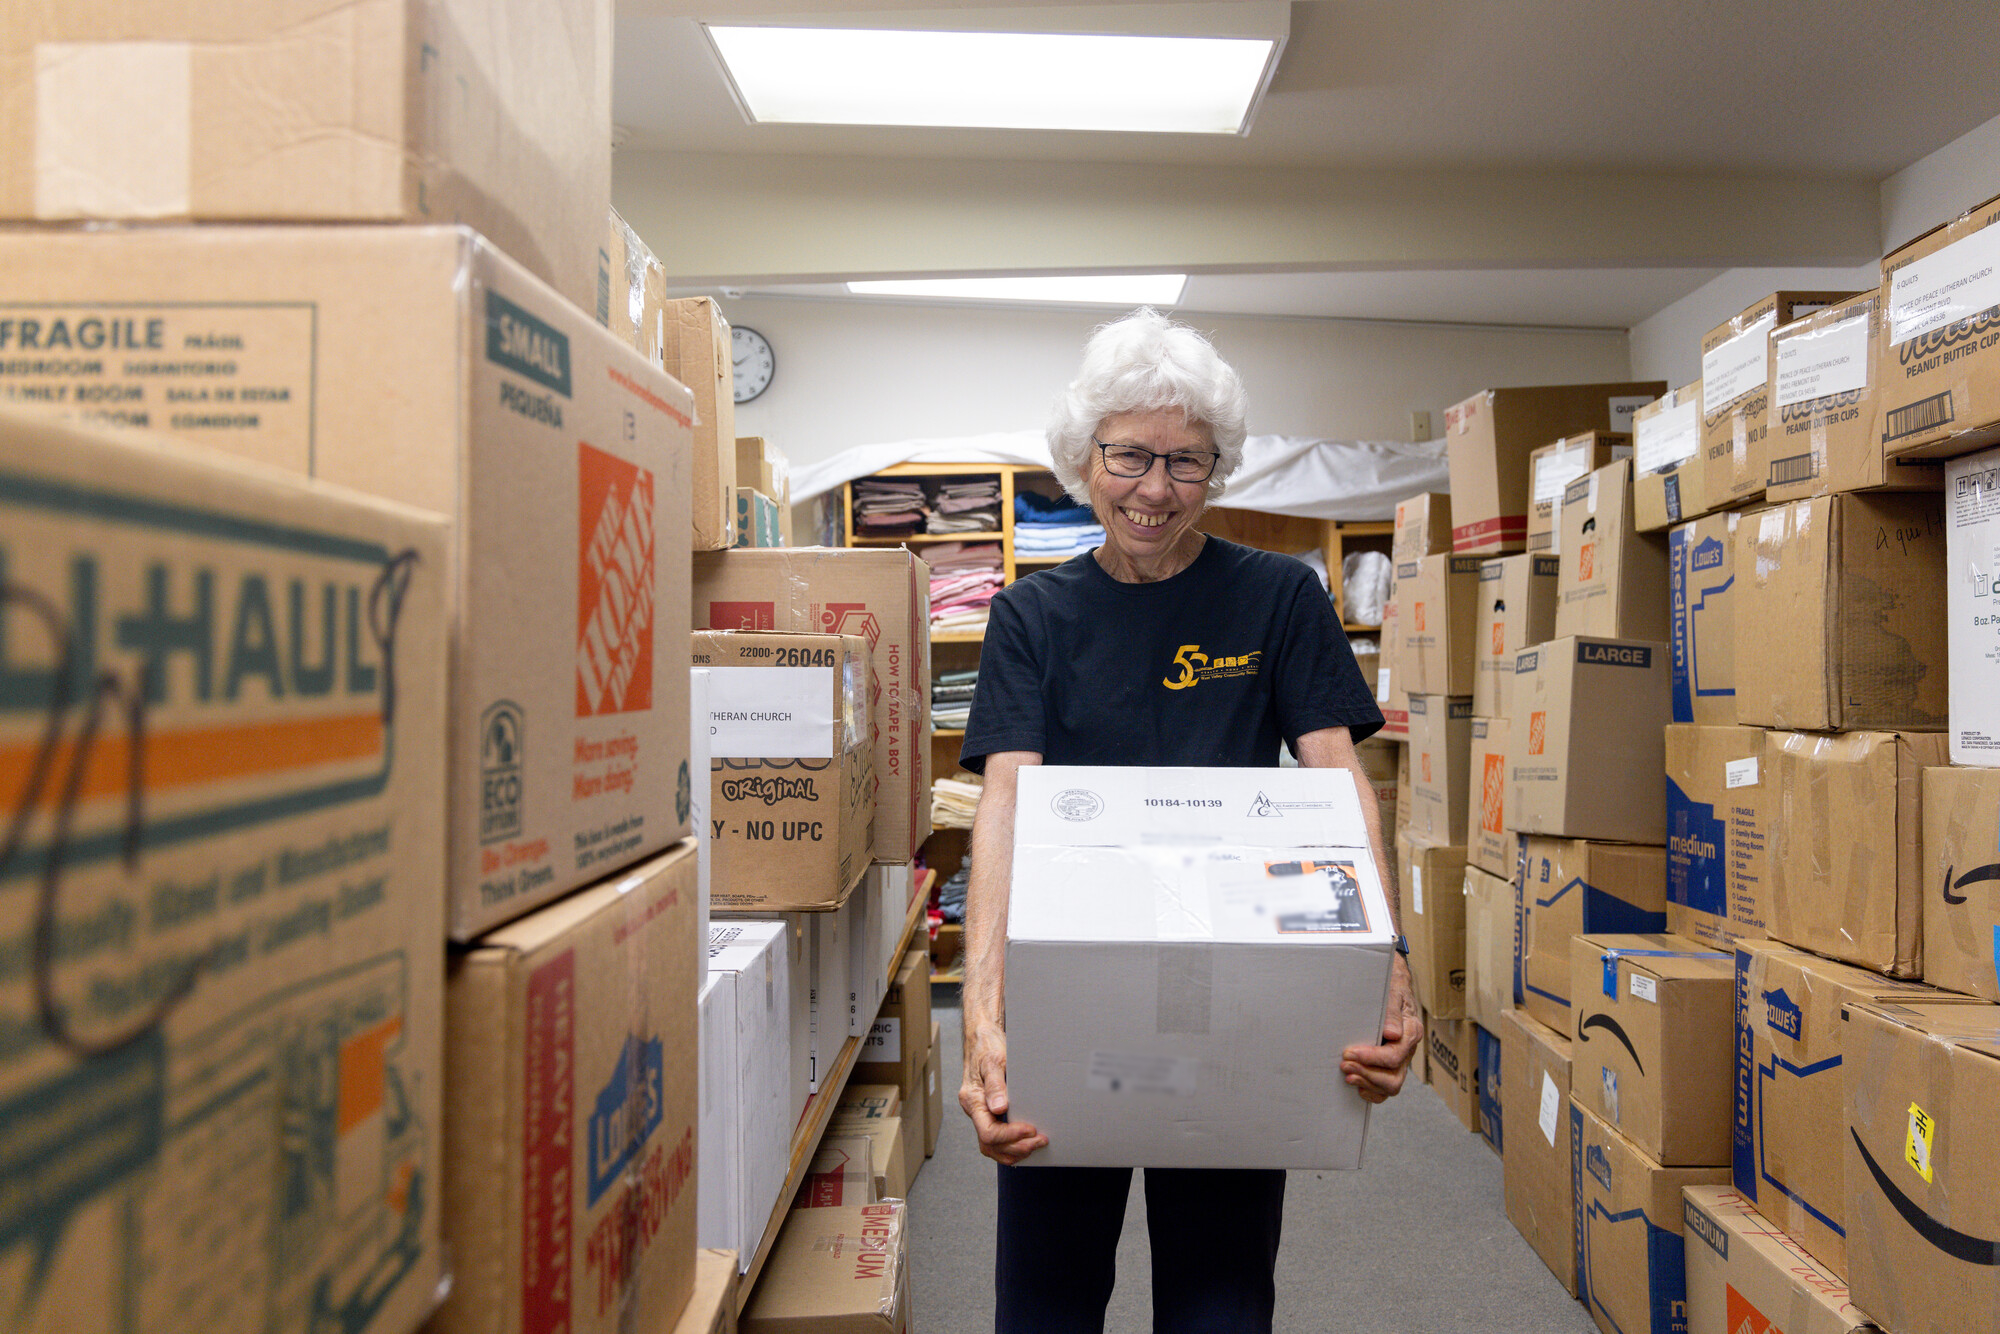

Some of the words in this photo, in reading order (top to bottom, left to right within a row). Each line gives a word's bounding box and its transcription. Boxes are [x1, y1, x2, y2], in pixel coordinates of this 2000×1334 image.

[1896, 282, 1901, 290] 6
[1901, 274, 1919, 288] QUILTS
[1914, 297, 1922, 307] OF
[1922, 289, 1938, 302] PEACE
[1968, 266, 1993, 284] CHURCH
[1929, 312, 1946, 325] 94536
[0, 318, 164, 350] FRAGILE
[500, 312, 562, 380] SMALL
[1906, 355, 1941, 379] PEANUT
[1943, 341, 1978, 365] BUTTER
[1980, 331, 2000, 350] CUP
[1832, 356, 1850, 367] CHURCH
[1786, 420, 1812, 435] PEANUT
[1840, 407, 1859, 422] CUPS
[1709, 443, 1725, 460] VEND
[1748, 428, 1758, 444] NO
[576, 466, 652, 707] HOME
[1673, 544, 1685, 667] medium
[1973, 616, 1979, 626] 8
[1980, 616, 1990, 626] oz.
[889, 644, 899, 677] HOW
[1518, 654, 1537, 670] LARGE
[1584, 646, 1644, 664] LARGE
[889, 680, 899, 699] TO
[750, 711, 792, 721] CHURCH
[889, 702, 899, 733] TAPE
[889, 736, 899, 745] A
[889, 749, 899, 776] BOX
[485, 776, 518, 809] ECO
[1143, 798, 1223, 808] 10184-10139
[1736, 807, 1755, 817] FRAGILE
[746, 820, 775, 841] NO
[782, 820, 823, 841] UPC
[1736, 818, 1756, 828] Bedroom
[1736, 828, 1750, 839] Family
[1750, 831, 1764, 840] Room
[1669, 833, 1716, 860] medium
[1736, 839, 1750, 851] Dining
[1750, 842, 1764, 851] Room
[1736, 850, 1753, 860] Kitchen
[1736, 861, 1747, 870] Bath
[1736, 871, 1758, 883] Basement
[1736, 882, 1747, 892] Attic
[1736, 893, 1755, 905] Laundry
[1737, 904, 1754, 916] Garage
[1768, 1003, 1798, 1034] OWE'S
[1738, 970, 1752, 1127] medium
[1573, 1121, 1584, 1253] medium
[1684, 1203, 1725, 1253] MEDIUM
[854, 1216, 890, 1280] MEDIUM
